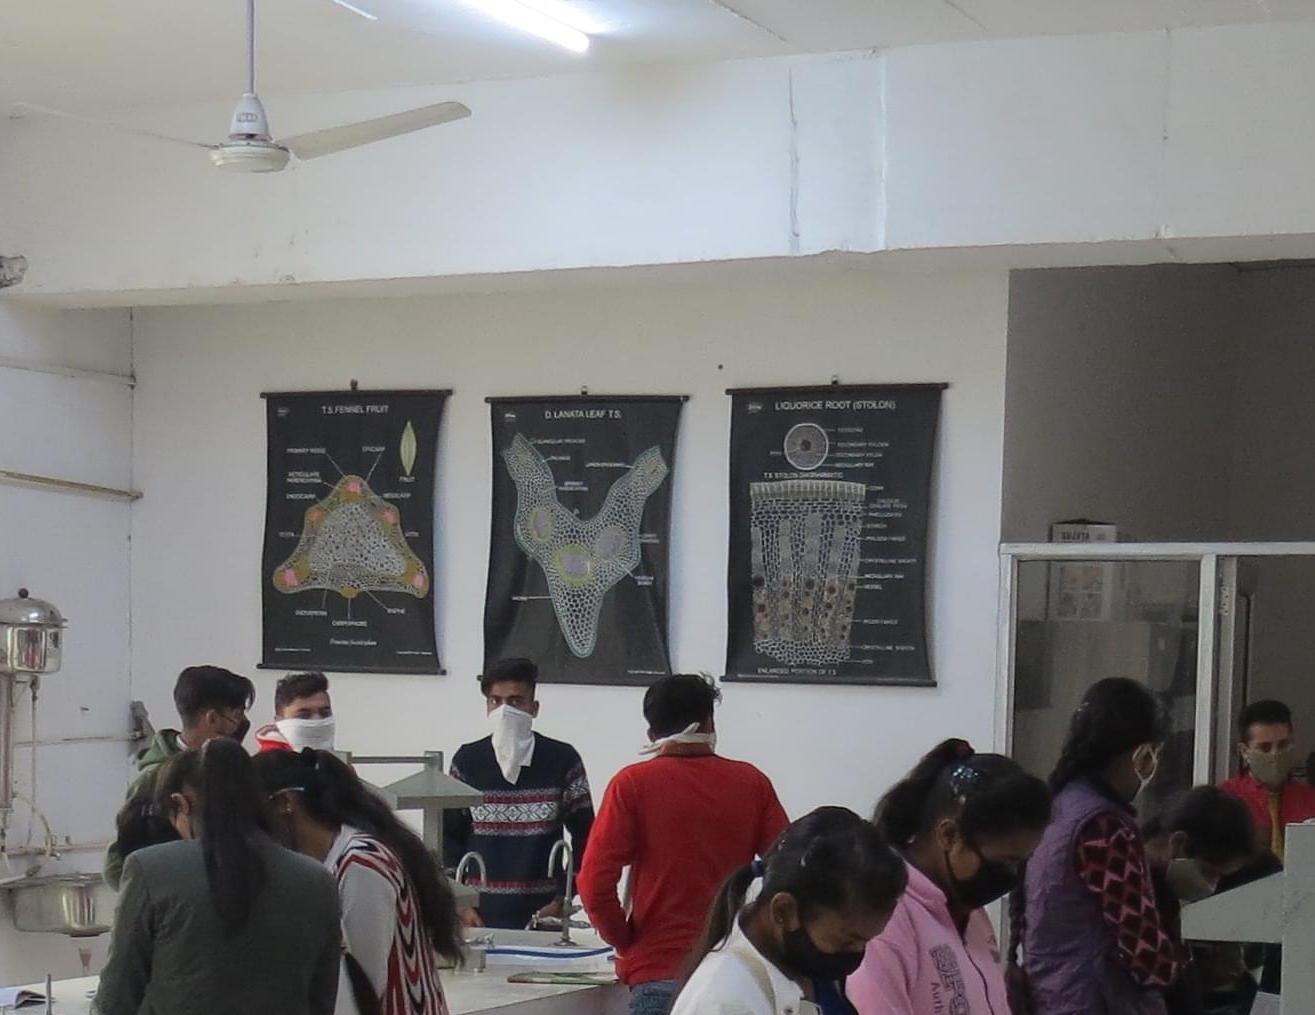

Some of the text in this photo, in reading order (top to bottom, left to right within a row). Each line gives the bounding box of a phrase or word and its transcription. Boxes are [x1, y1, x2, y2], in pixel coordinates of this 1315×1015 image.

[334, 405, 364, 414] FENNEL
[366, 404, 389, 413] FRUIT
[775, 401, 896, 411] LIQUORICE ROOT (STOLON)
[554, 410, 584, 418] LANATA
[585, 410, 605, 418] LEAF
